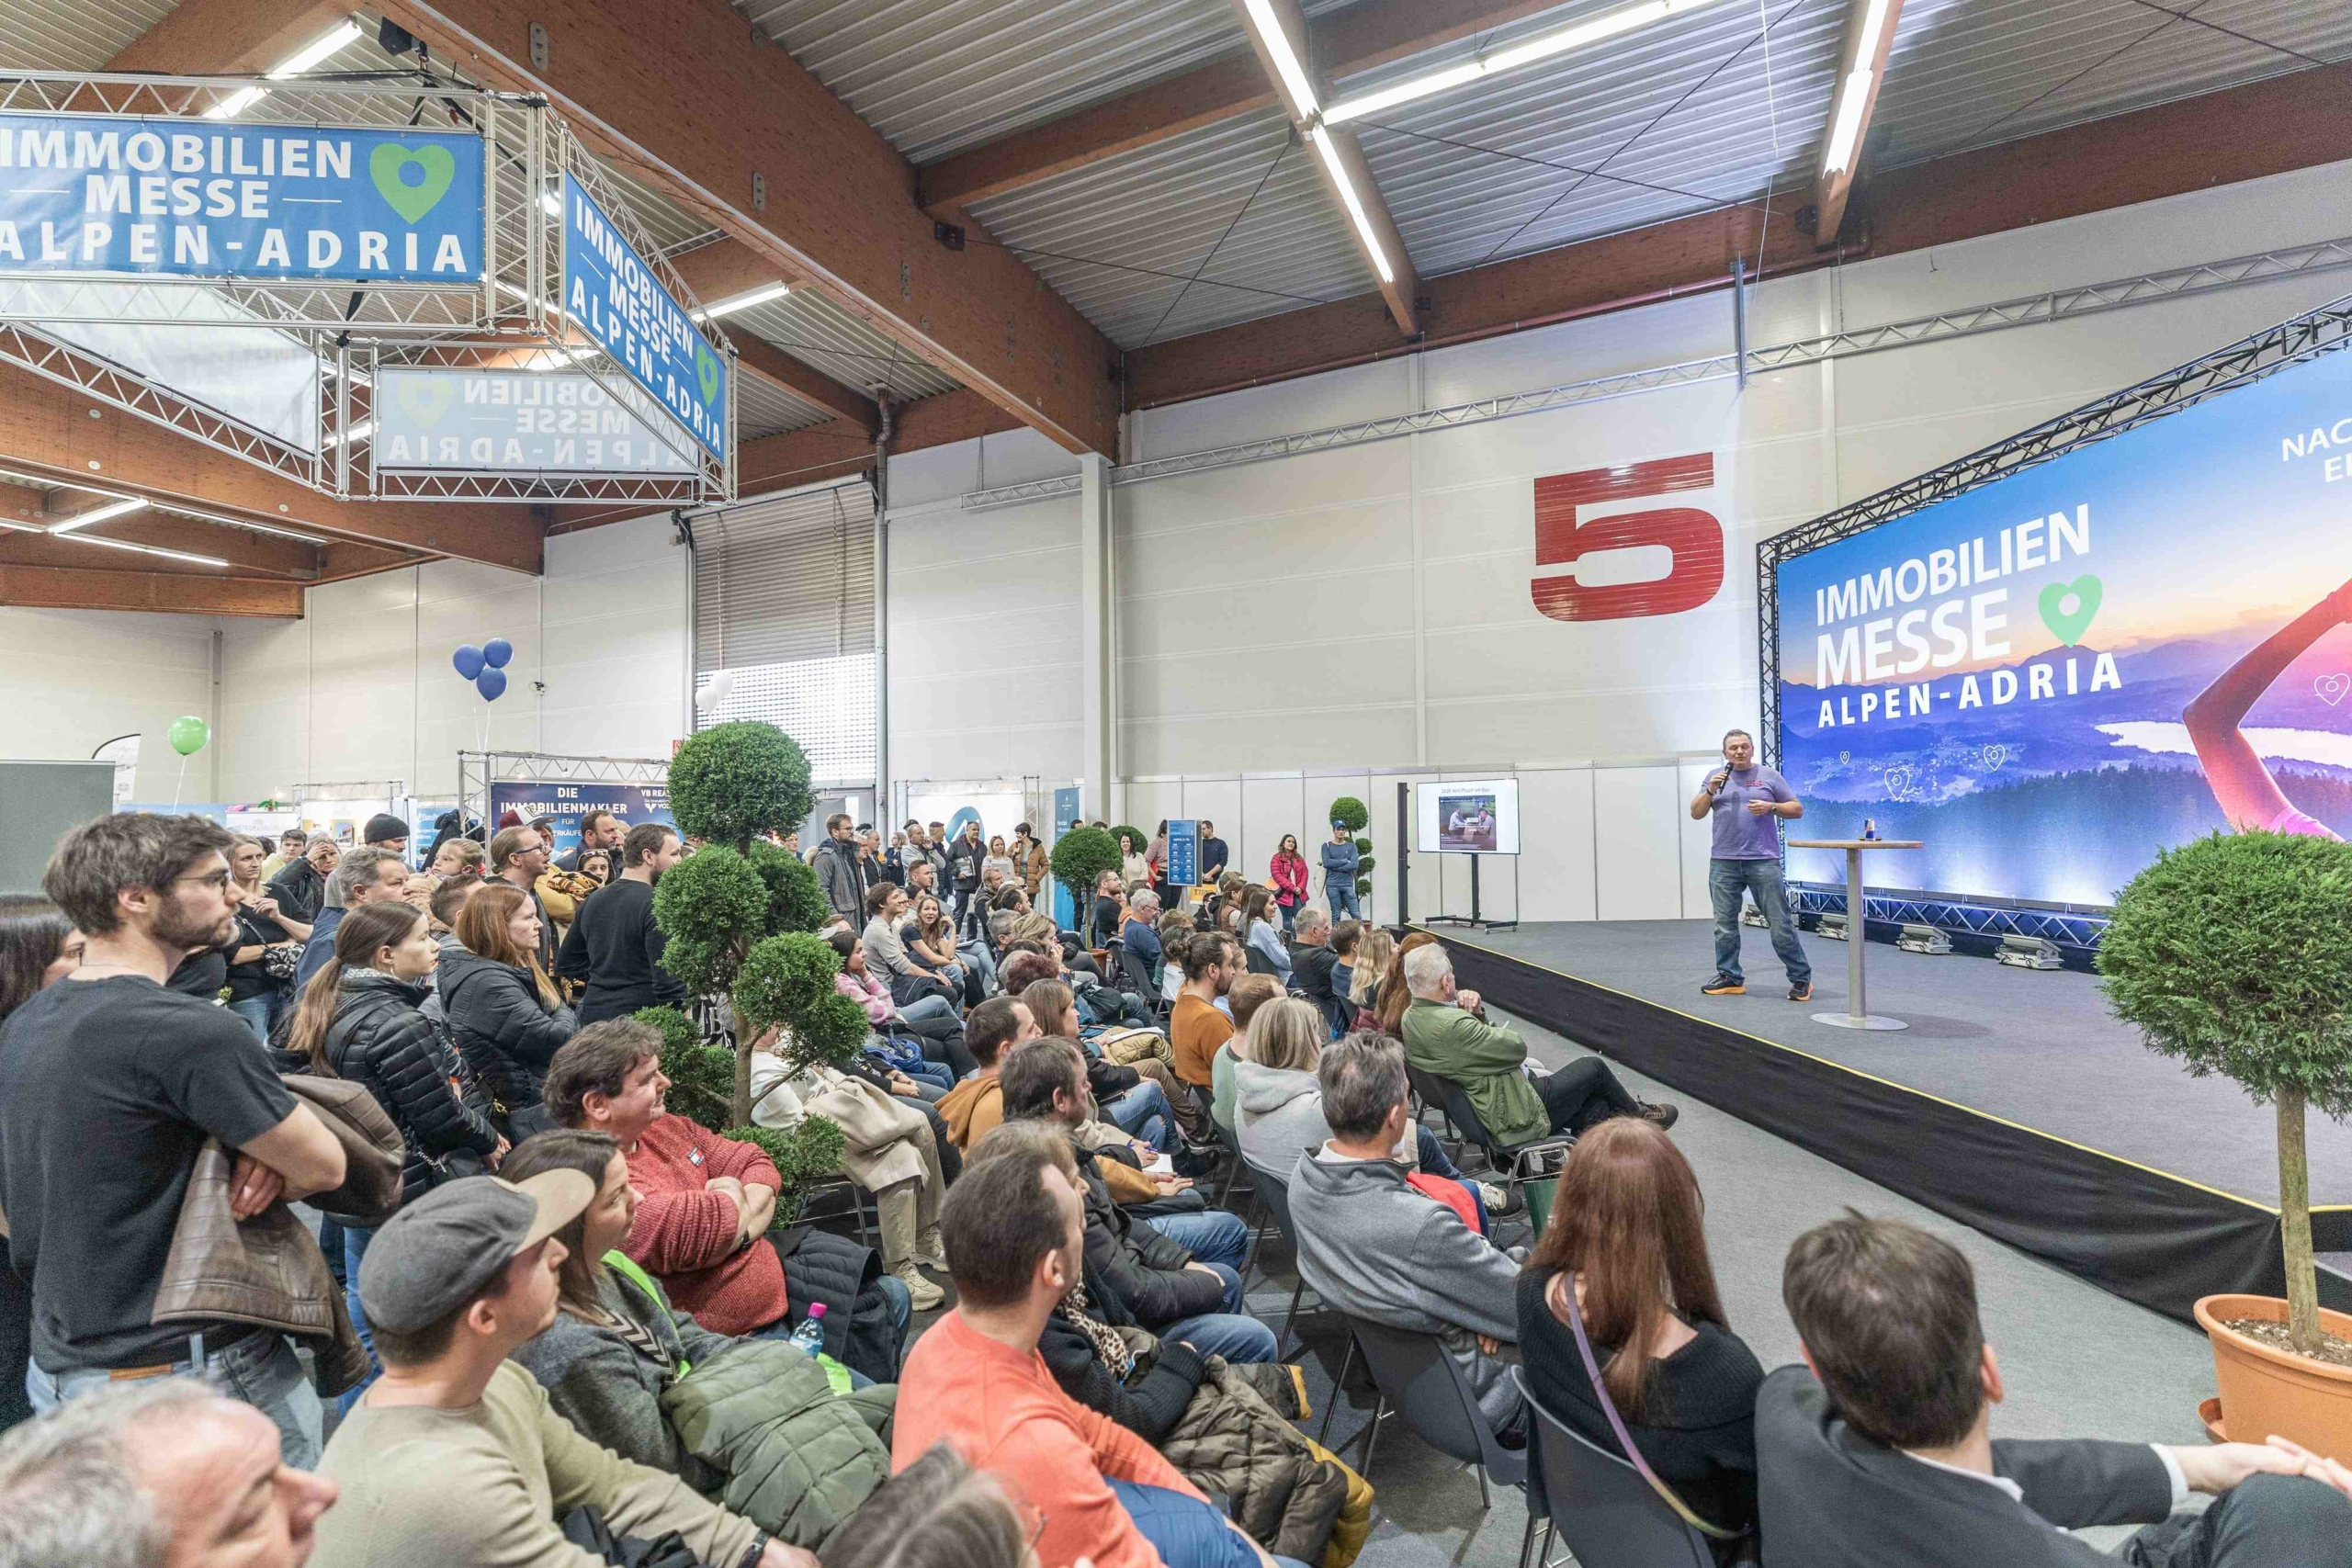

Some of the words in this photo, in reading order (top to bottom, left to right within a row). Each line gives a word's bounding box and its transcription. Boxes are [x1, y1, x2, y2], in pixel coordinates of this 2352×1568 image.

[0, 128, 352, 179] IMMOBILIEN
[85, 175, 269, 219] MESSE
[0, 220, 468, 274] ALPEN-ADRIA
[576, 194, 694, 360] IMMOBILIEN
[609, 272, 671, 366] MESSE
[571, 275, 720, 453] ALPEN-ADRIA
[1531, 451, 1724, 623] 5
[1815, 502, 2090, 626] IMMOBILIEN
[1815, 588, 2010, 691] MESSE
[1818, 651, 2122, 728] ALPEN-ADRIA
[557, 787, 579, 798] DIE
[561, 817, 575, 825] FÜR
[640, 789, 651, 797] VB
